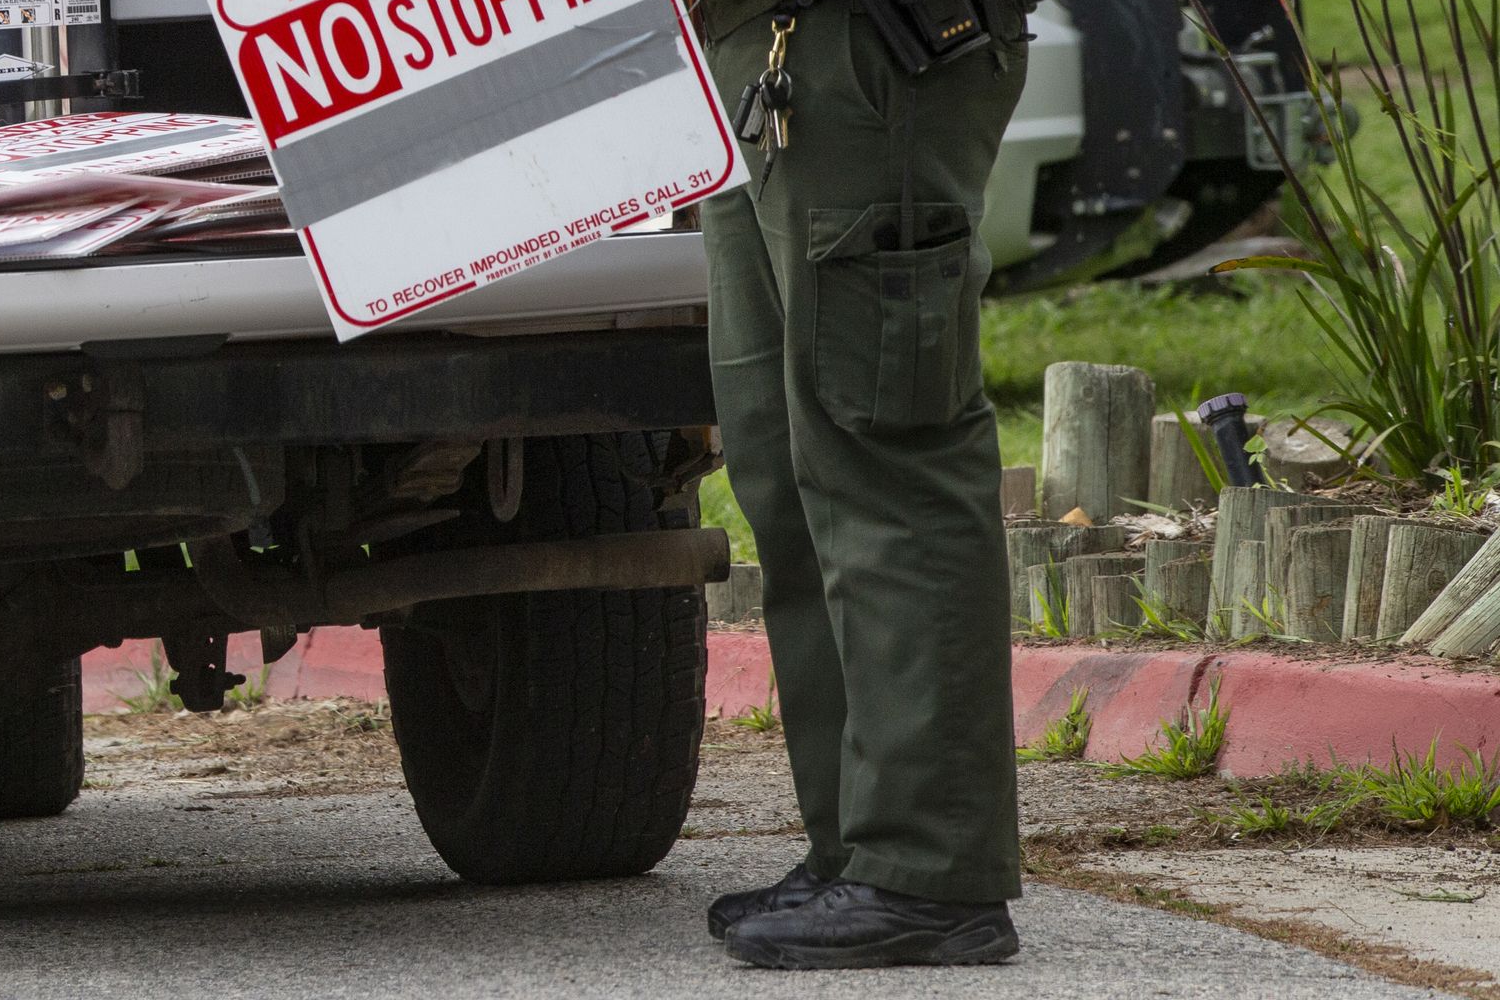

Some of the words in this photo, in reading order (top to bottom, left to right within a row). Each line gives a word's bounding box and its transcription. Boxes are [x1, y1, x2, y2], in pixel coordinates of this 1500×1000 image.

[255, 1, 383, 123] NO
[8, 116, 218, 154] STOPPING
[366, 298, 388, 316] TO
[392, 267, 466, 307] RECOVER
[469, 230, 561, 276] IMPOUNDED
[564, 198, 640, 237] VEHICLES
[644, 182, 685, 206] CALL
[688, 169, 713, 188] 311
[486, 263, 521, 282] PROPERTY
[524, 255, 541, 267] CITY
[544, 250, 552, 260] OF
[555, 244, 568, 255] LOS
[570, 230, 602, 249] ANGELES
